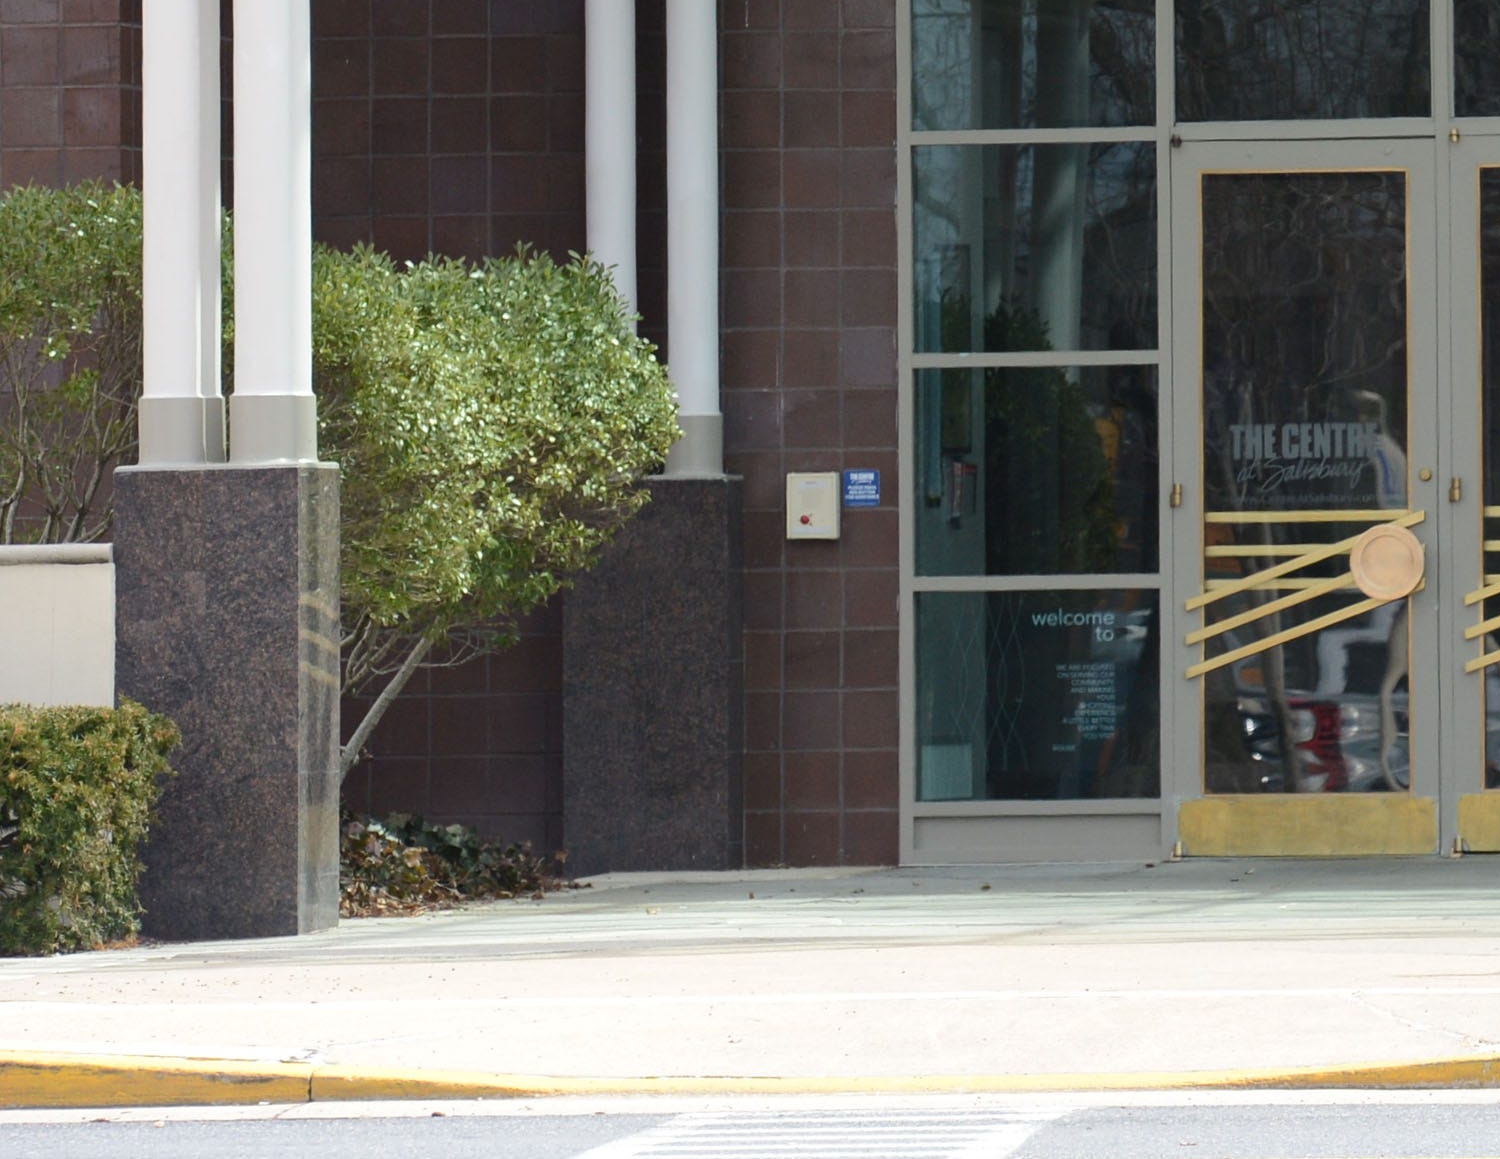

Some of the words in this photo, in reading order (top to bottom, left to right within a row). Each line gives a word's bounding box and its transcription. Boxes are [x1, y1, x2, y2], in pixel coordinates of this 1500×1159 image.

[1229, 423, 1277, 460] THE
[1281, 422, 1379, 460] CENTRE
[1260, 456, 1371, 493] Salisbury
[1032, 608, 1115, 626] welcome
[1096, 627, 1114, 642] to
